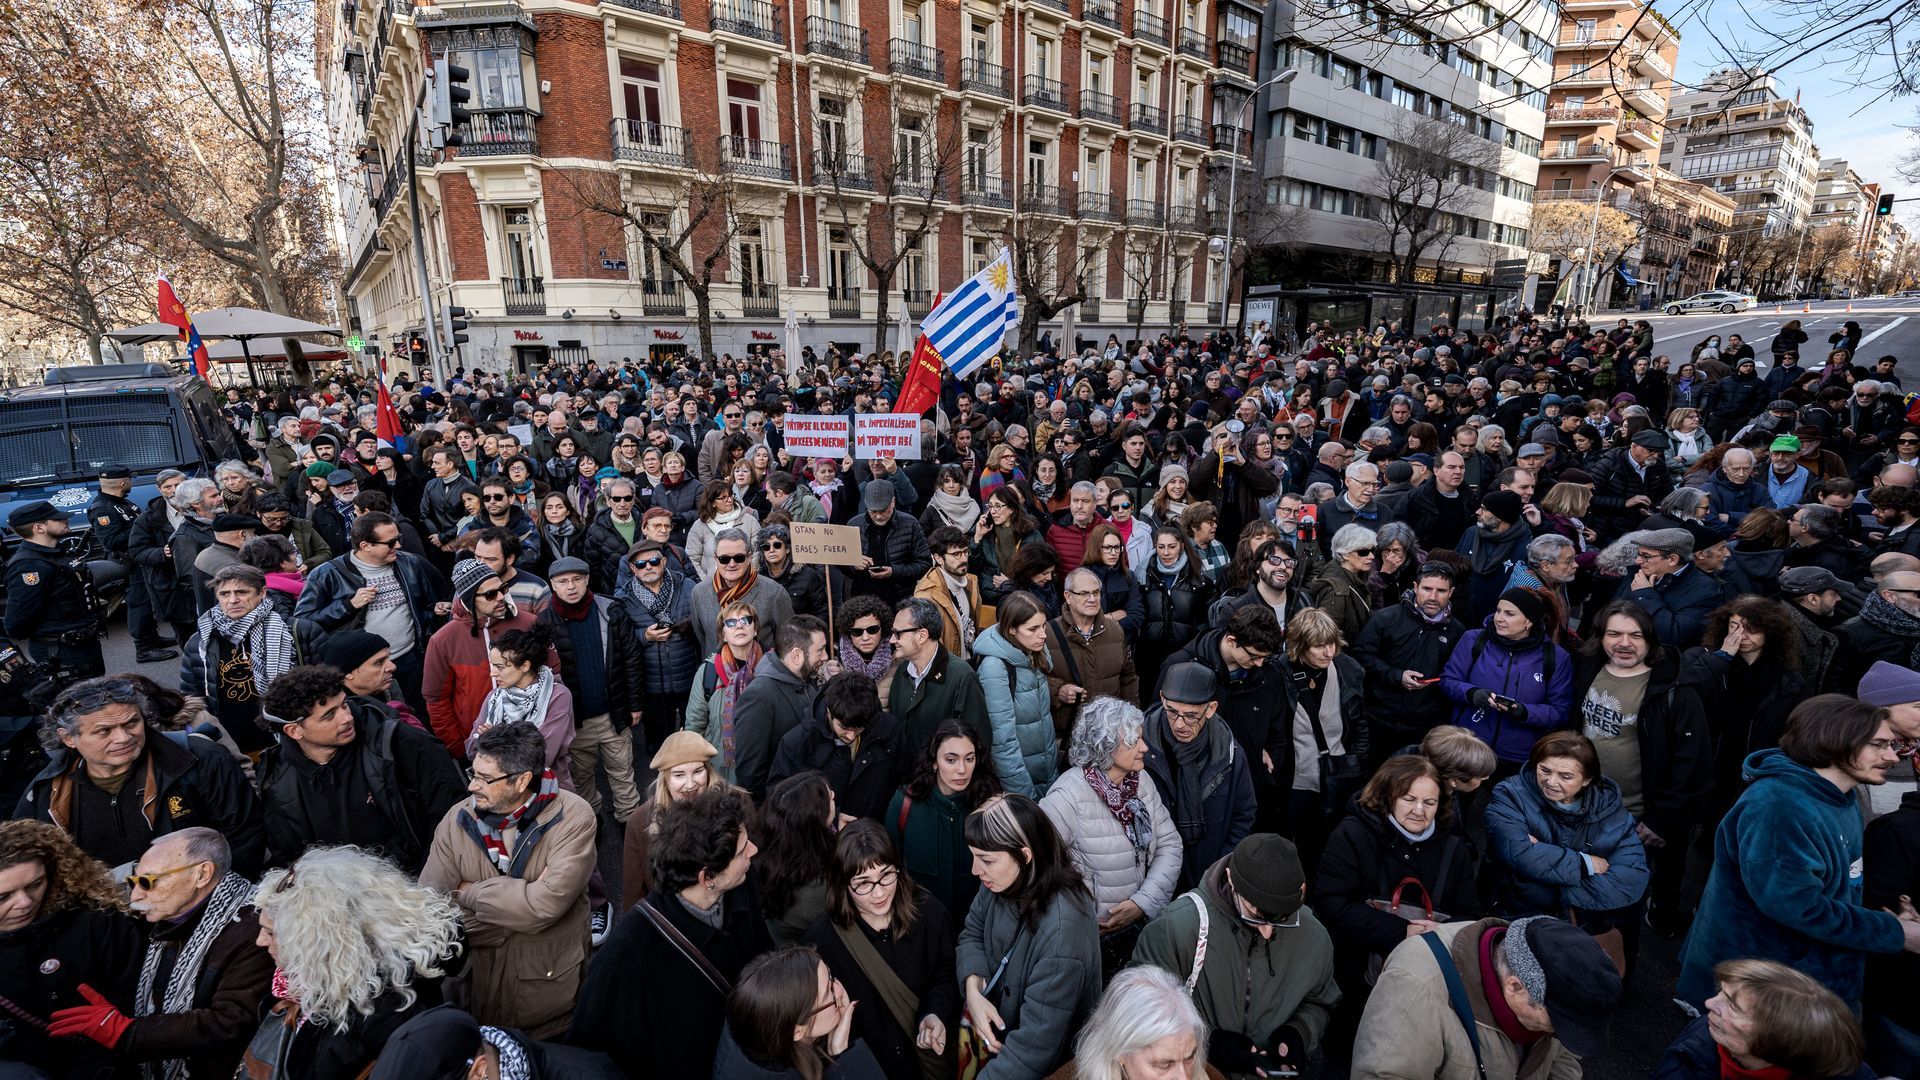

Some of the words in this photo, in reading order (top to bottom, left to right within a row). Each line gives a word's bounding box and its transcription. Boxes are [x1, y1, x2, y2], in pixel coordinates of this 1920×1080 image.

[1249, 302, 1272, 310] LOEWE
[858, 419, 867, 428] AL
[795, 526, 815, 535] OTAN
[824, 528, 834, 536] NO
[795, 544, 818, 554] BASES
[823, 545, 847, 554] FUERA
